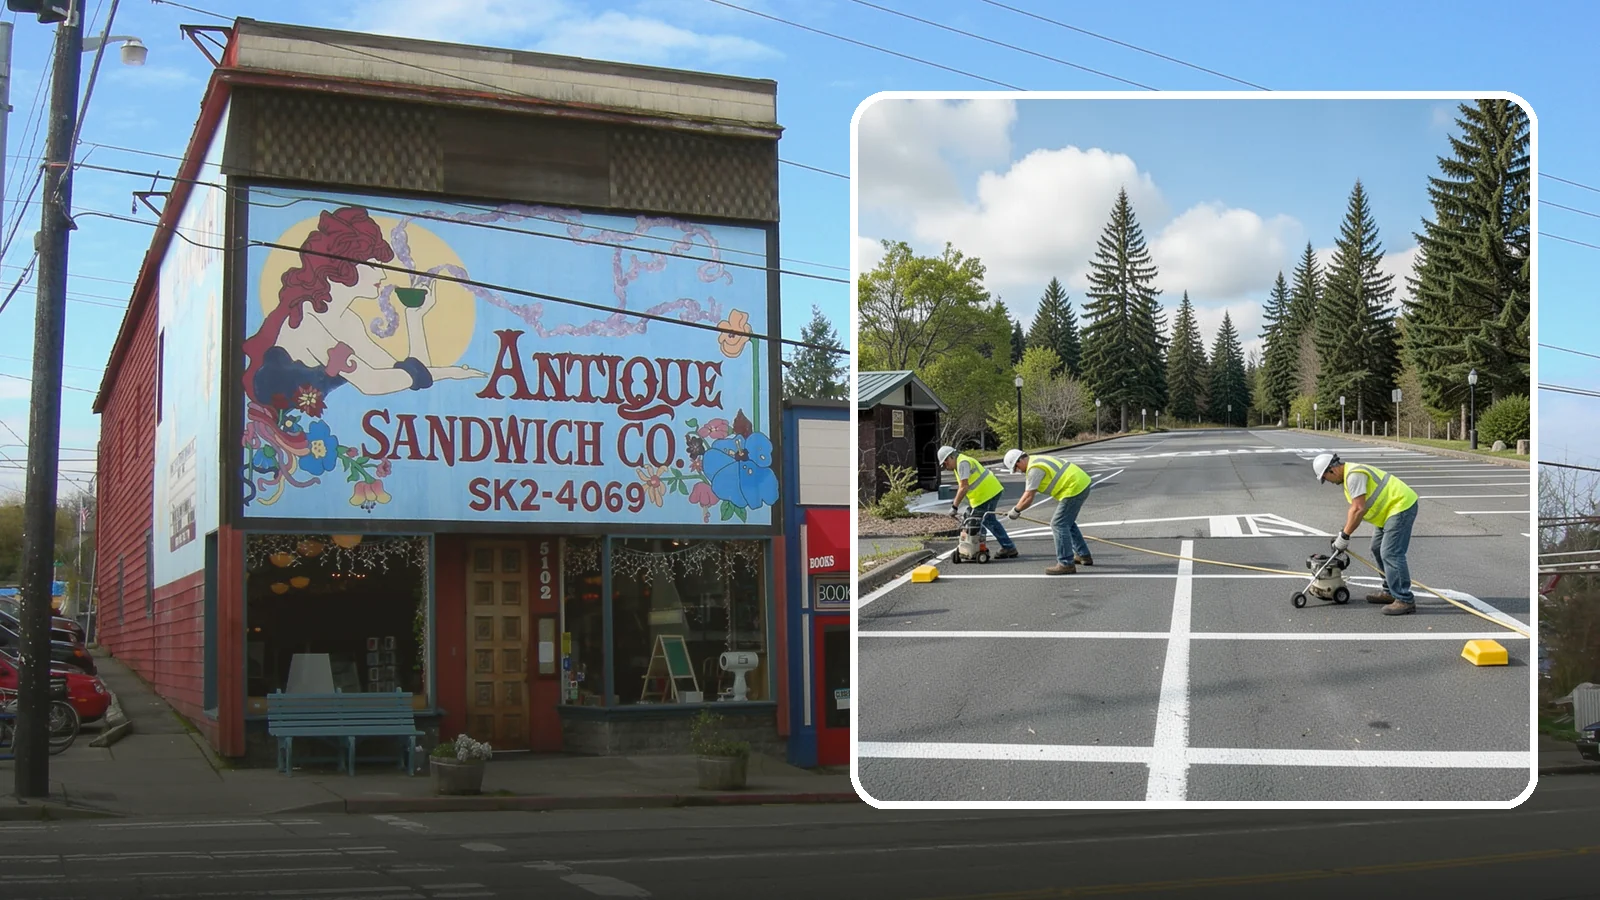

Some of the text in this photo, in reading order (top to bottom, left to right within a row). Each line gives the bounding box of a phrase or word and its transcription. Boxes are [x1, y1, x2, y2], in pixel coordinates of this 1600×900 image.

[475, 329, 724, 421] ANTIQUE
[361, 408, 685, 469] SANDWICH CO.
[467, 477, 646, 513] SK2-4069
[539, 541, 552, 600] 5102
[809, 554, 835, 569] BOOKS
